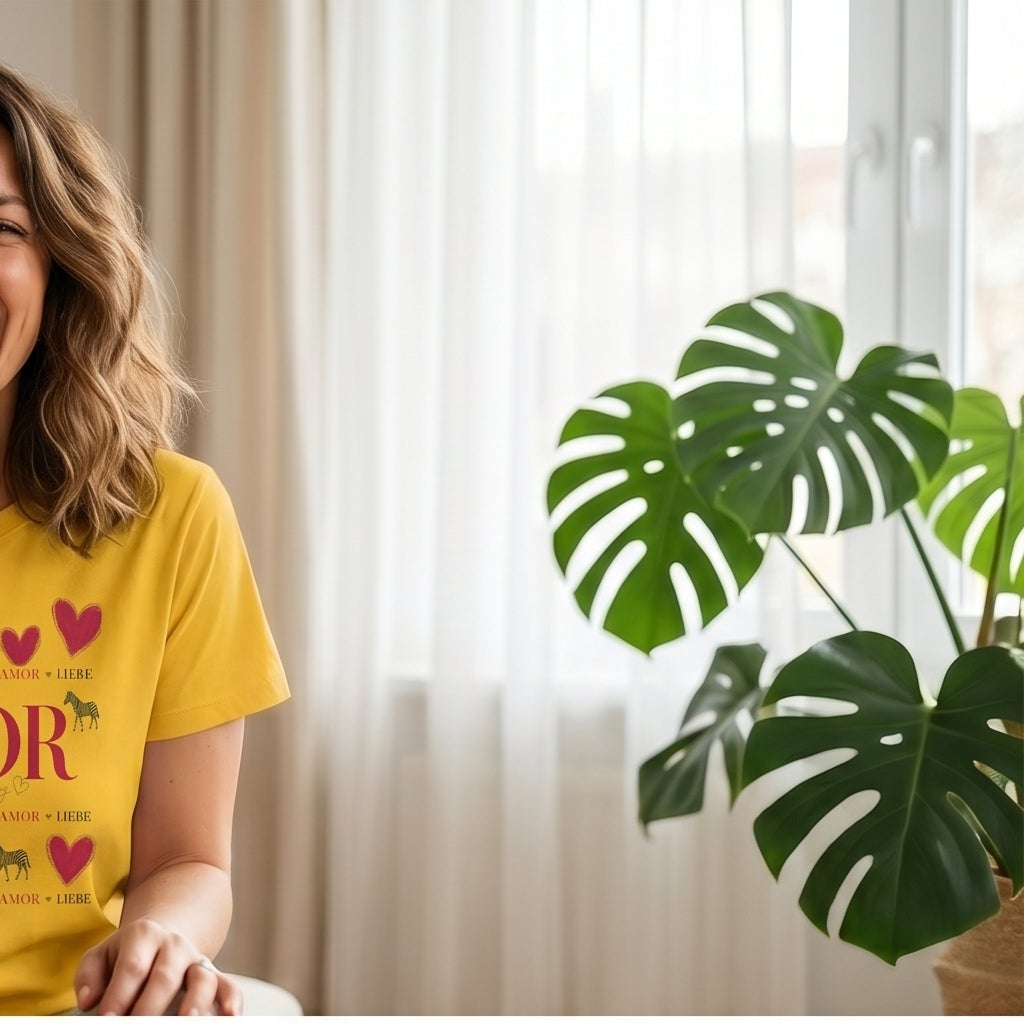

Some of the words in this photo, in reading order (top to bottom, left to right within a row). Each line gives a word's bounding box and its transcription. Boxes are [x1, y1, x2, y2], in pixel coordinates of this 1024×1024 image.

[0, 668, 40, 680] AMOR
[56, 668, 94, 680] LIEBE
[0, 810, 40, 822] AMOR
[56, 810, 94, 822] LIEBE
[0, 893, 40, 905] AMOR
[56, 893, 94, 905] LIEBE
